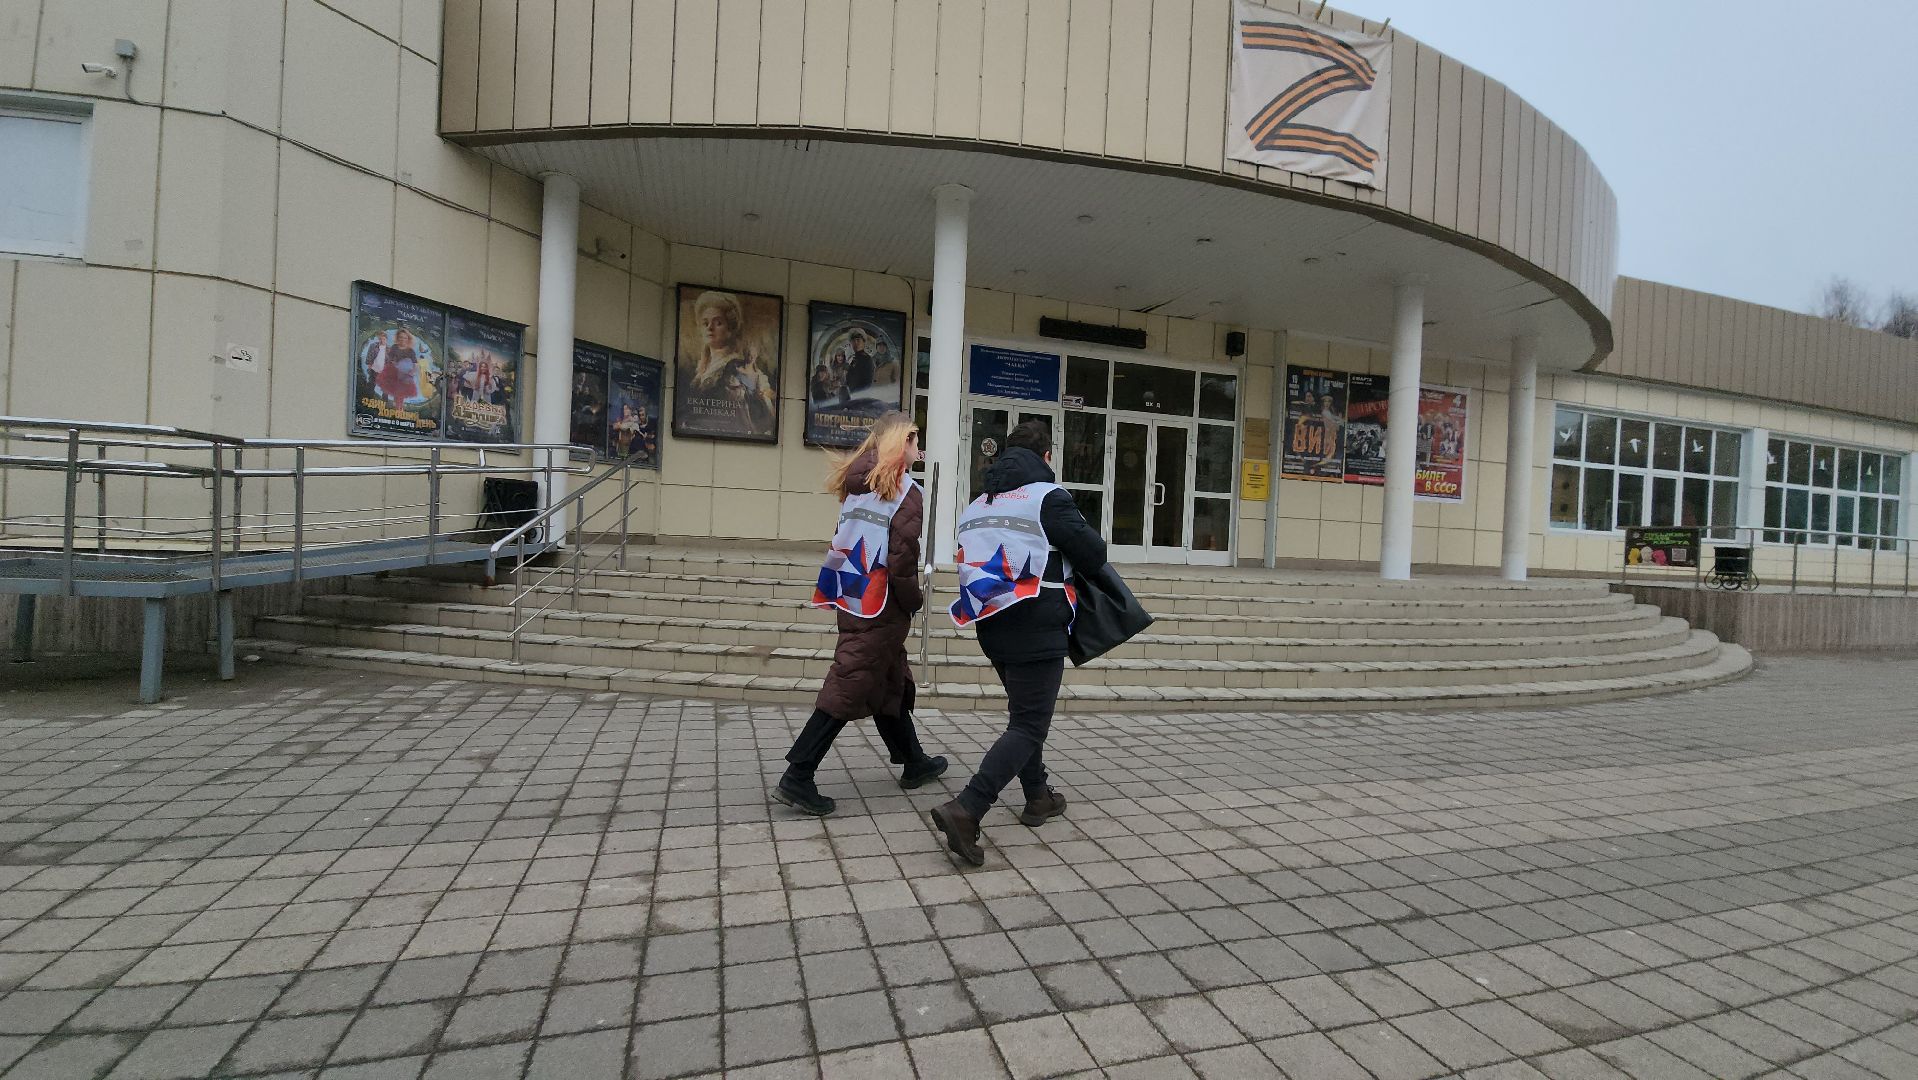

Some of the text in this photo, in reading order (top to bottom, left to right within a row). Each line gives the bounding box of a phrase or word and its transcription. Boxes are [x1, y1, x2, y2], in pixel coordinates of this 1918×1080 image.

[1240, 20, 1380, 173] Z
[687, 397, 742, 409] ЕКАТЕРИНА
[692, 406, 736, 417] ВЕЛИКАЯ
[1415, 469, 1447, 481] БИЛЕТ
[1425, 480, 1458, 494] В СССР
